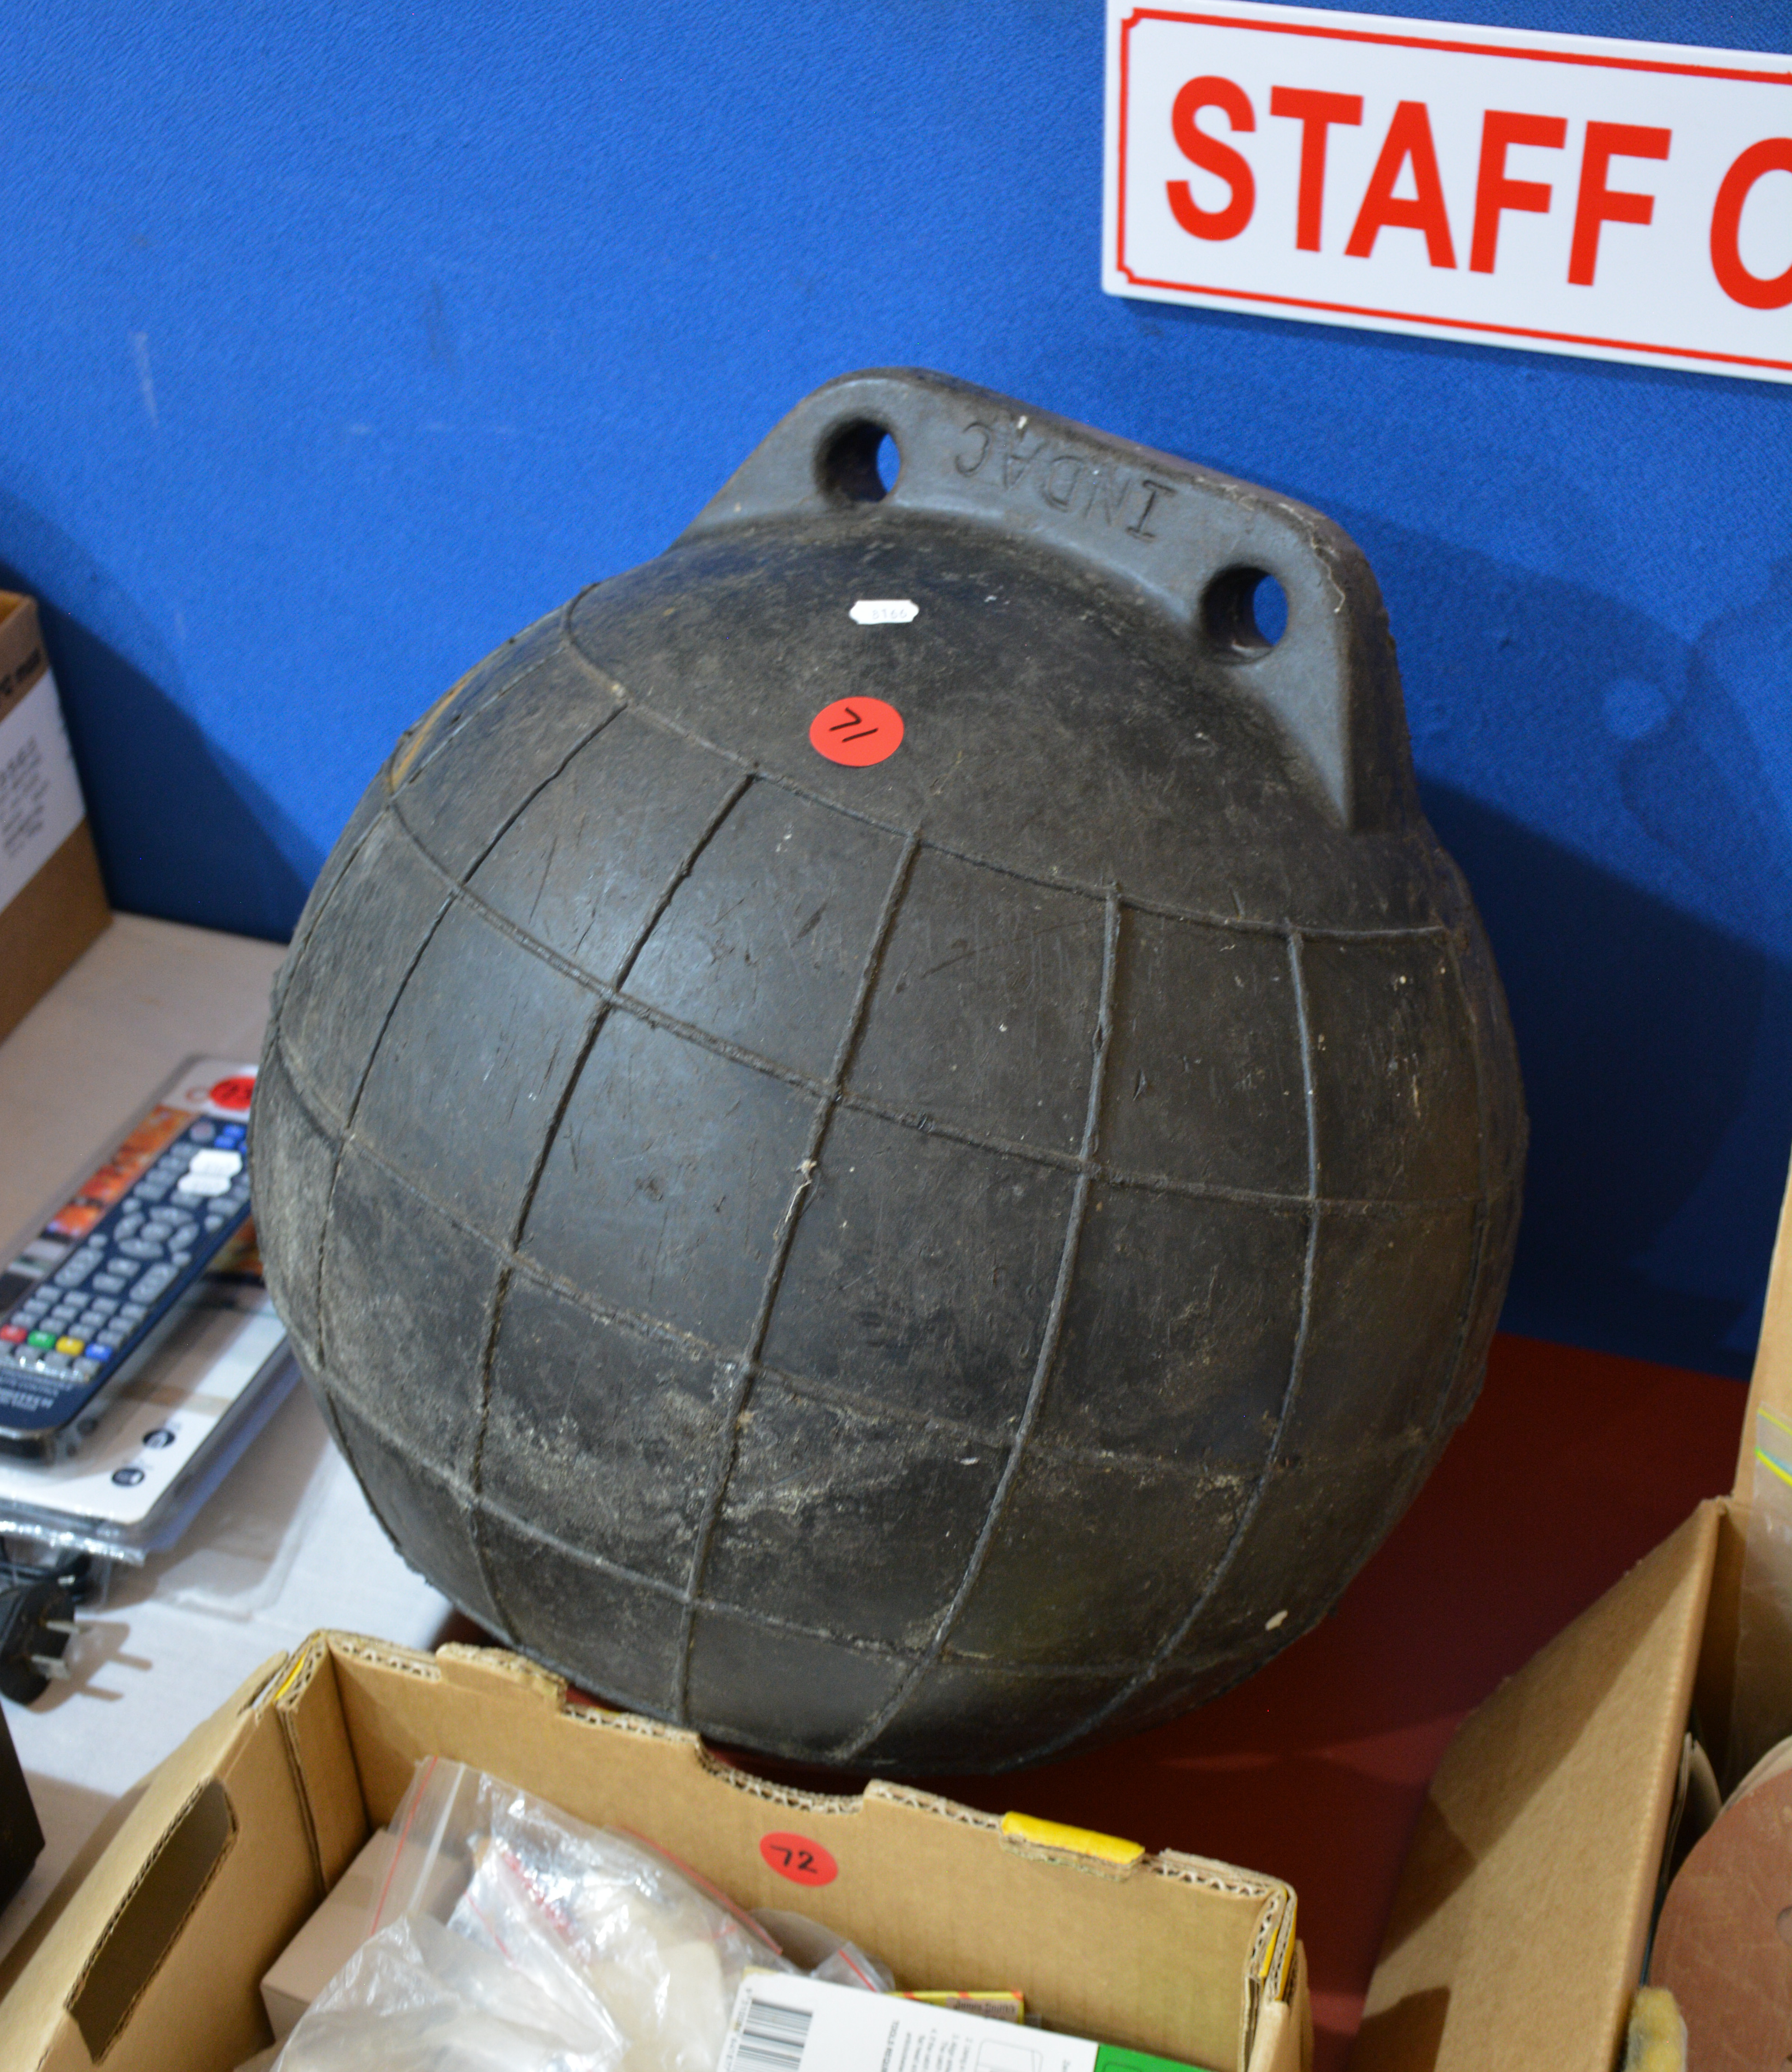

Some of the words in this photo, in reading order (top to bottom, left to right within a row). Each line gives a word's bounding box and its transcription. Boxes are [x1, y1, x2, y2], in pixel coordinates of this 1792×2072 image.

[1165, 75, 1673, 287] STAFF
[954, 419, 1177, 538] INDAC
[769, 1843, 818, 1875] 72
